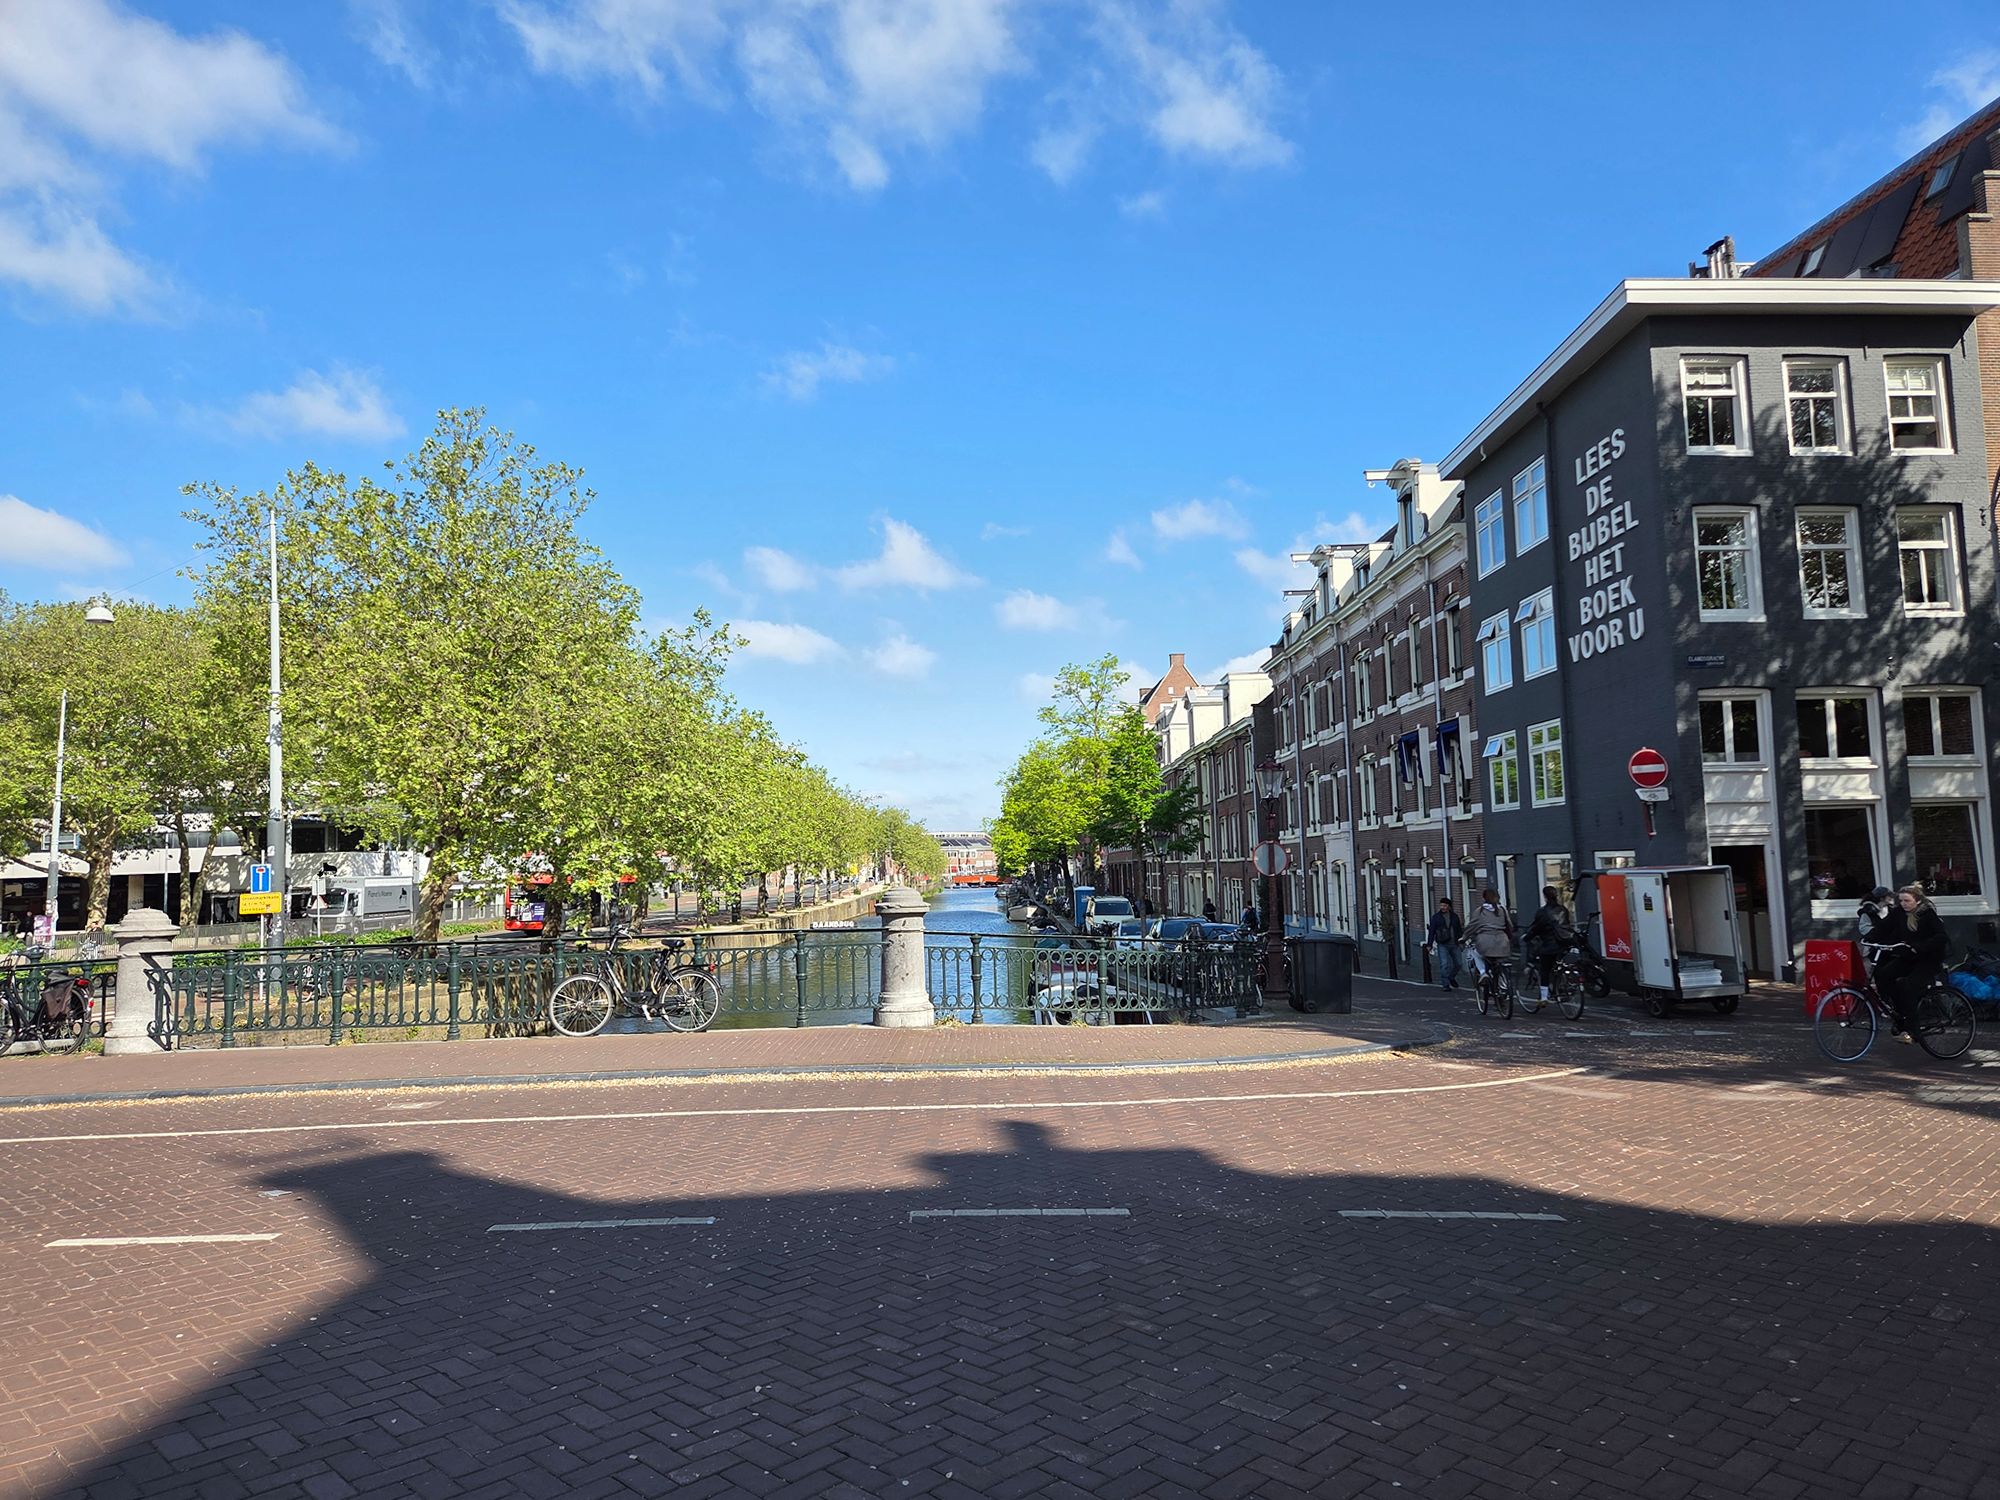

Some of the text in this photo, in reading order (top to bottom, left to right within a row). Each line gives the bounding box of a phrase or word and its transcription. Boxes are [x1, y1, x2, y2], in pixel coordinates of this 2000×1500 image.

[1575, 428, 1626, 486] LEES
[1586, 475, 1614, 516] DE
[1568, 501, 1639, 562] BIJBEL
[1585, 542, 1625, 587] HET
[1580, 574, 1636, 625] BOEK
[1568, 607, 1645, 662] VOOR U
